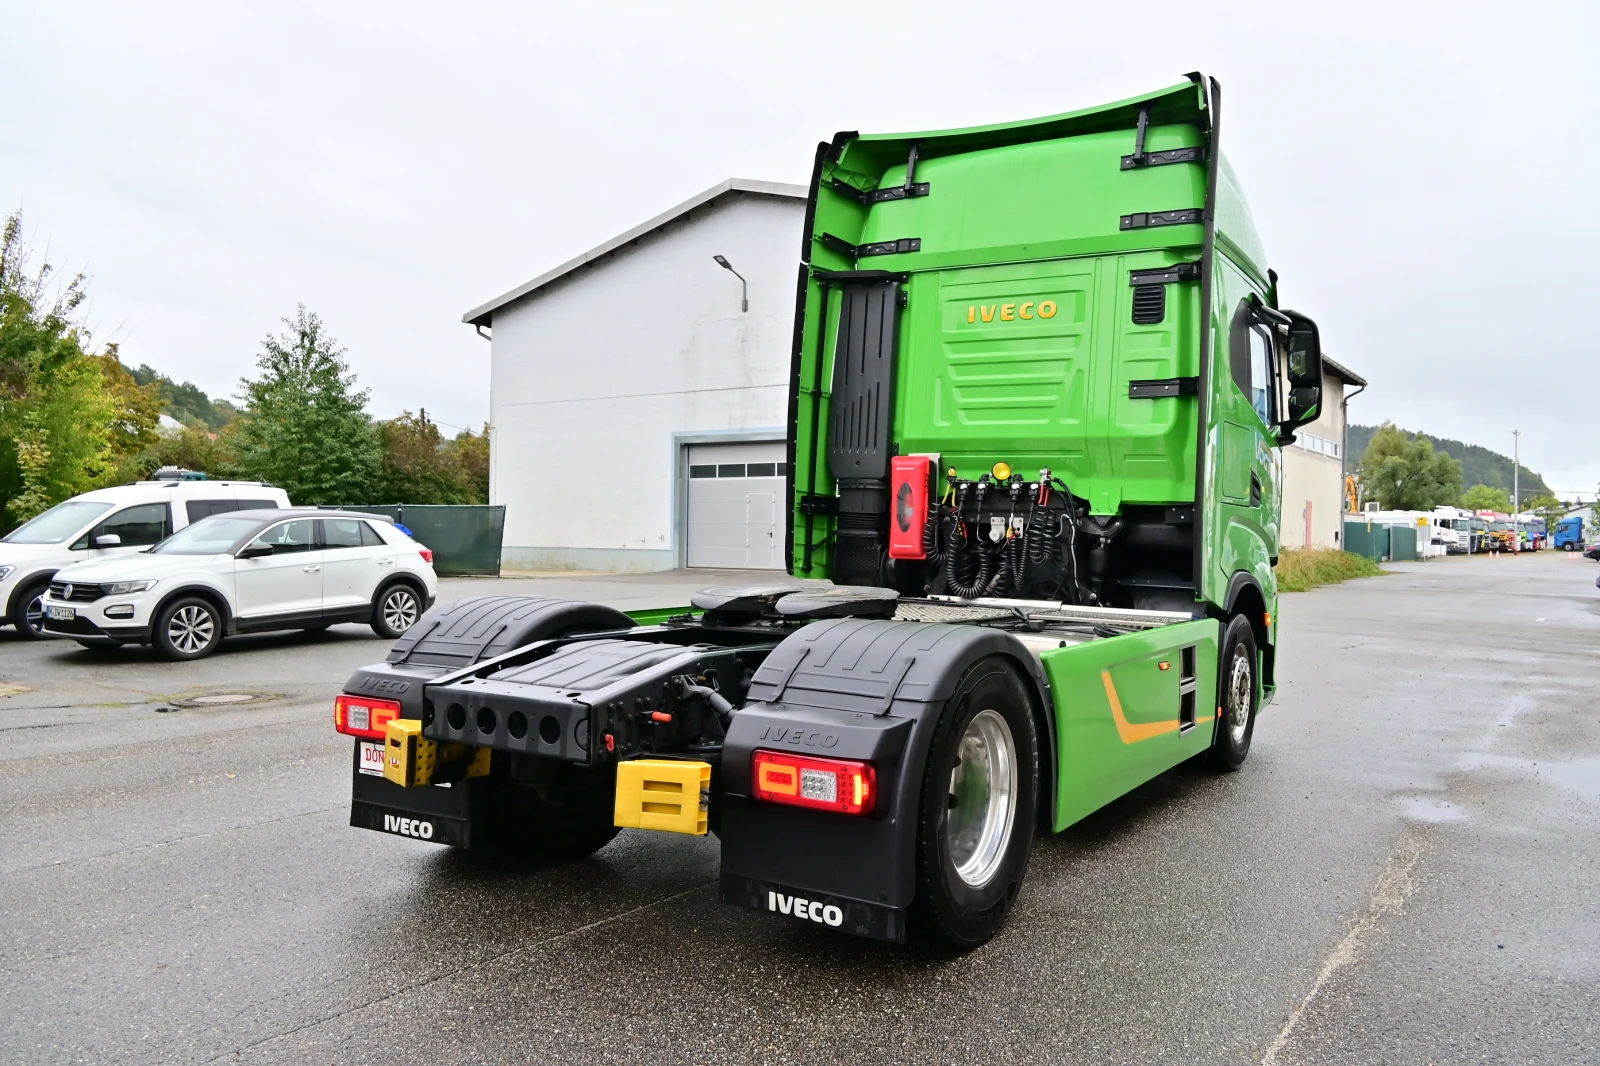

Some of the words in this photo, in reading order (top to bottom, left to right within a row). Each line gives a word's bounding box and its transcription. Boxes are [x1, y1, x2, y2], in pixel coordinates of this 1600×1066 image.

[967, 300, 1058, 324] IVECO
[360, 676, 411, 694] IVECO
[759, 724, 840, 749] IVECO
[384, 814, 434, 839] IVECO
[768, 891, 843, 927] IVECO
